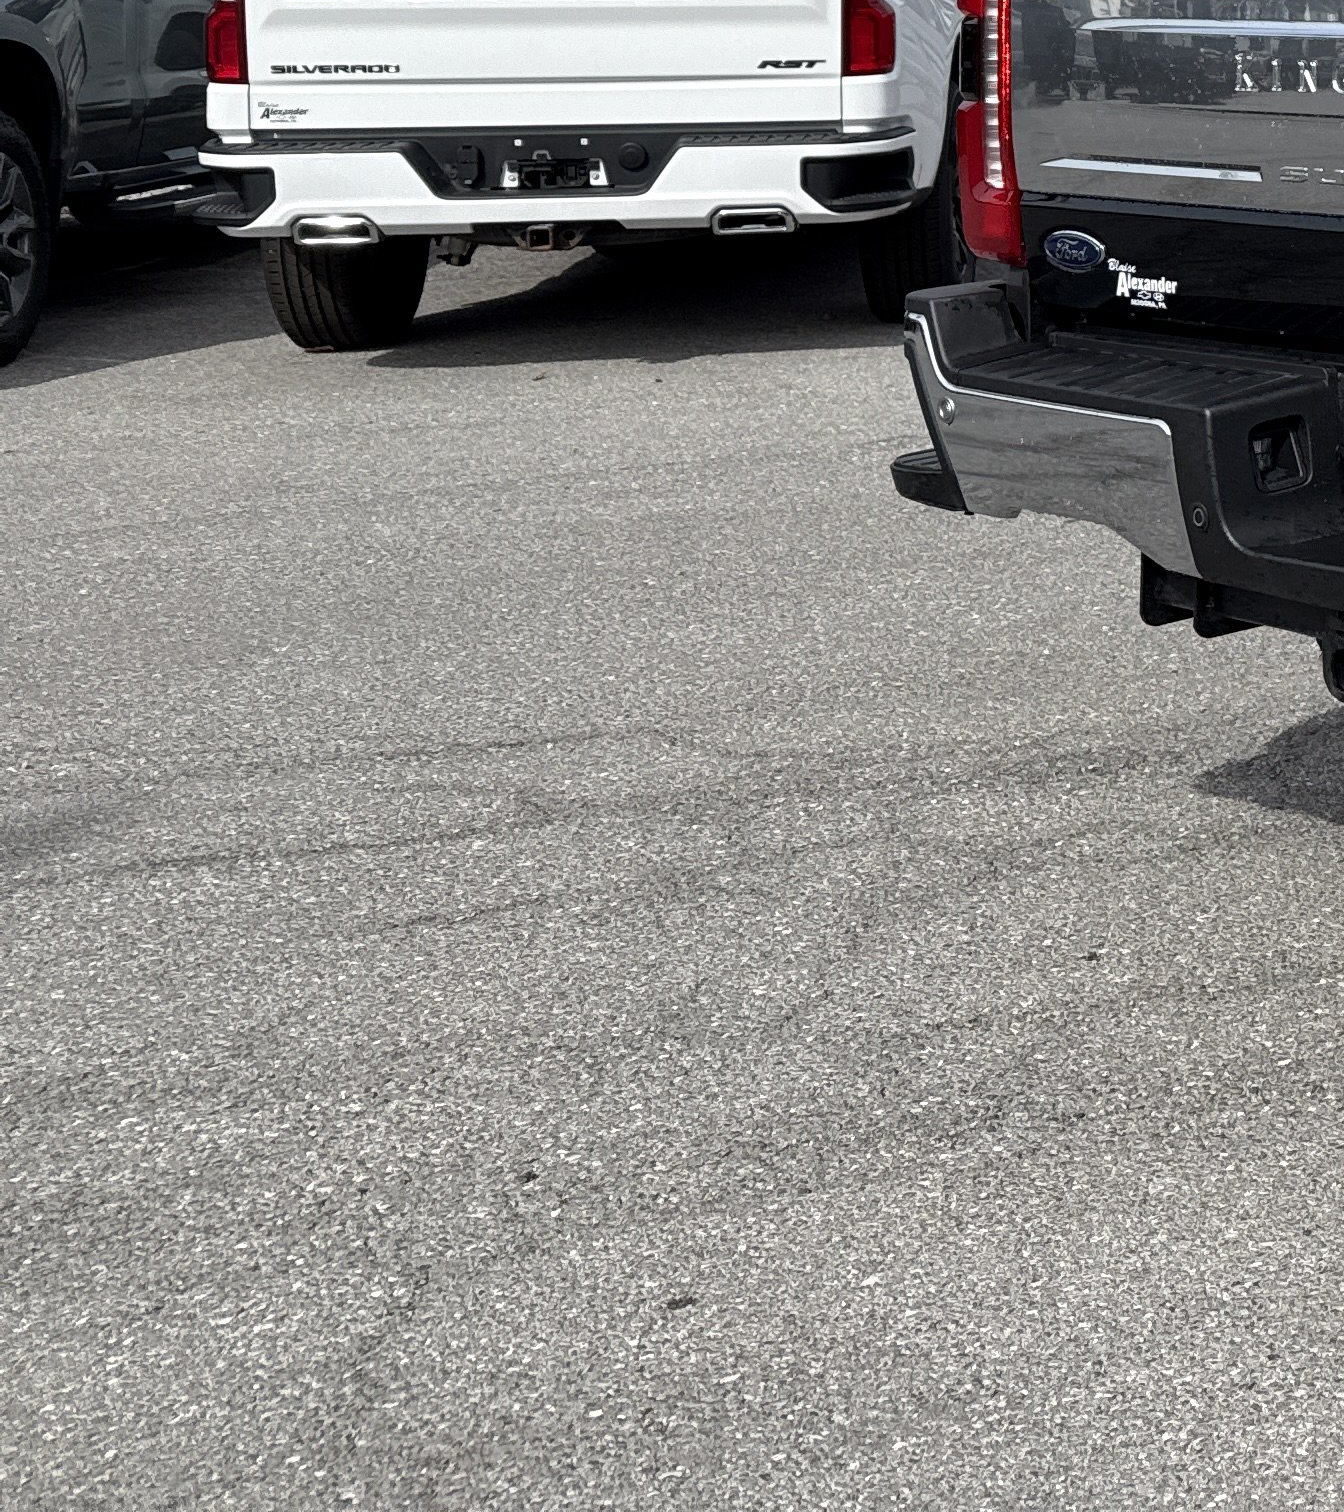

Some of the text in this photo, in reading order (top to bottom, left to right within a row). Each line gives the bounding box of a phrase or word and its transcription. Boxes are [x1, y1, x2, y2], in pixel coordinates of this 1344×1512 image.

[270, 64, 401, 74] SILVERADO
[757, 59, 827, 69] RST
[1055, 238, 1089, 262] Ford
[1115, 271, 1178, 298] Alexander
